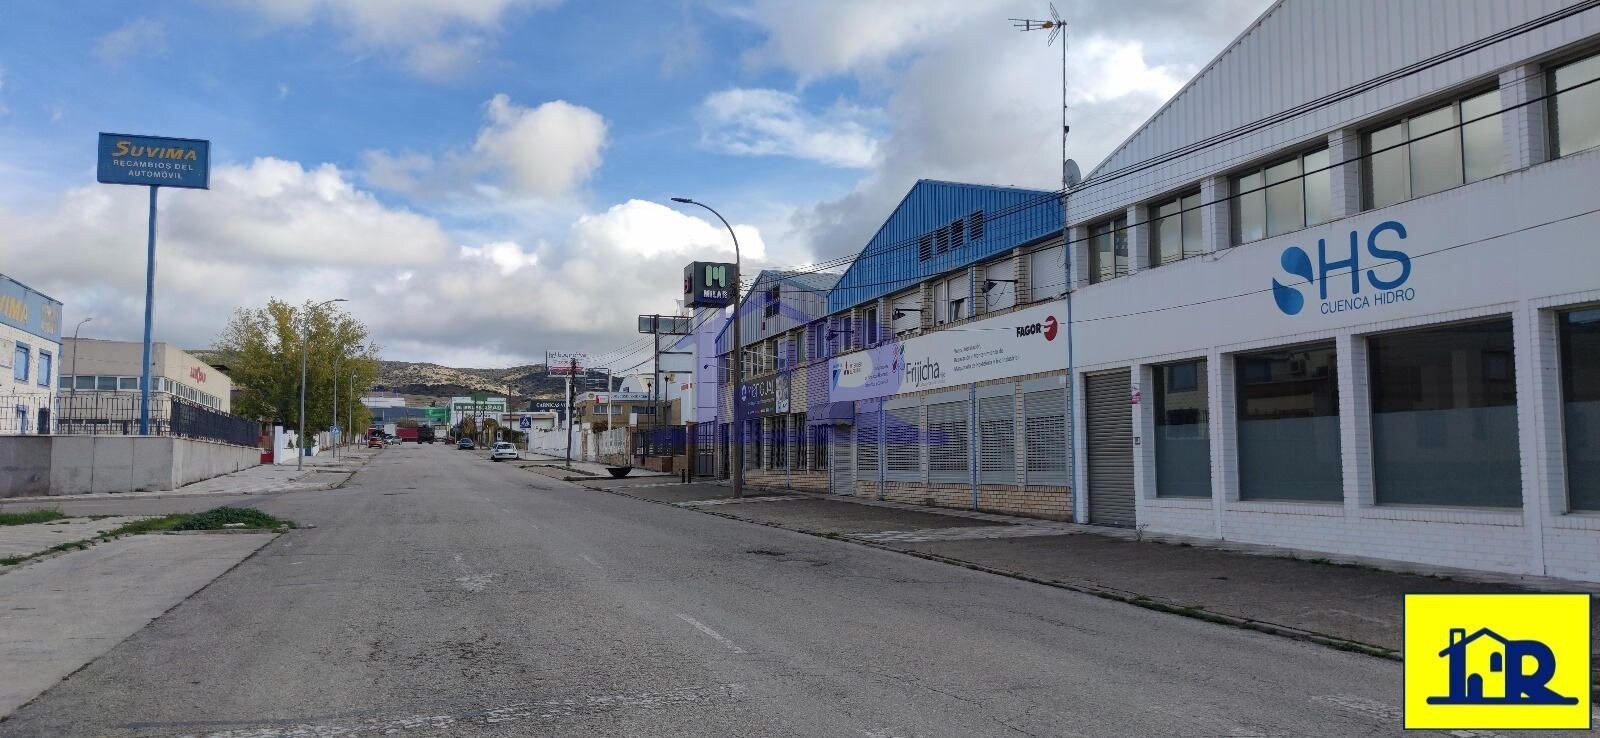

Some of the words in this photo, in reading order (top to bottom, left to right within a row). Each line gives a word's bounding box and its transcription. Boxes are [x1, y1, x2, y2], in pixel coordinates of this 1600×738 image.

[112, 139, 198, 161] SUVIMA
[113, 159, 171, 170] RECAMBIOS
[174, 163, 193, 171] DEL
[1318, 220, 1412, 300] HS
[1320, 296, 1371, 315] CUENCA
[1374, 287, 1416, 306] HIDRO
[1016, 322, 1042, 338] FAGOR
[905, 357, 940, 388] Frijicha
